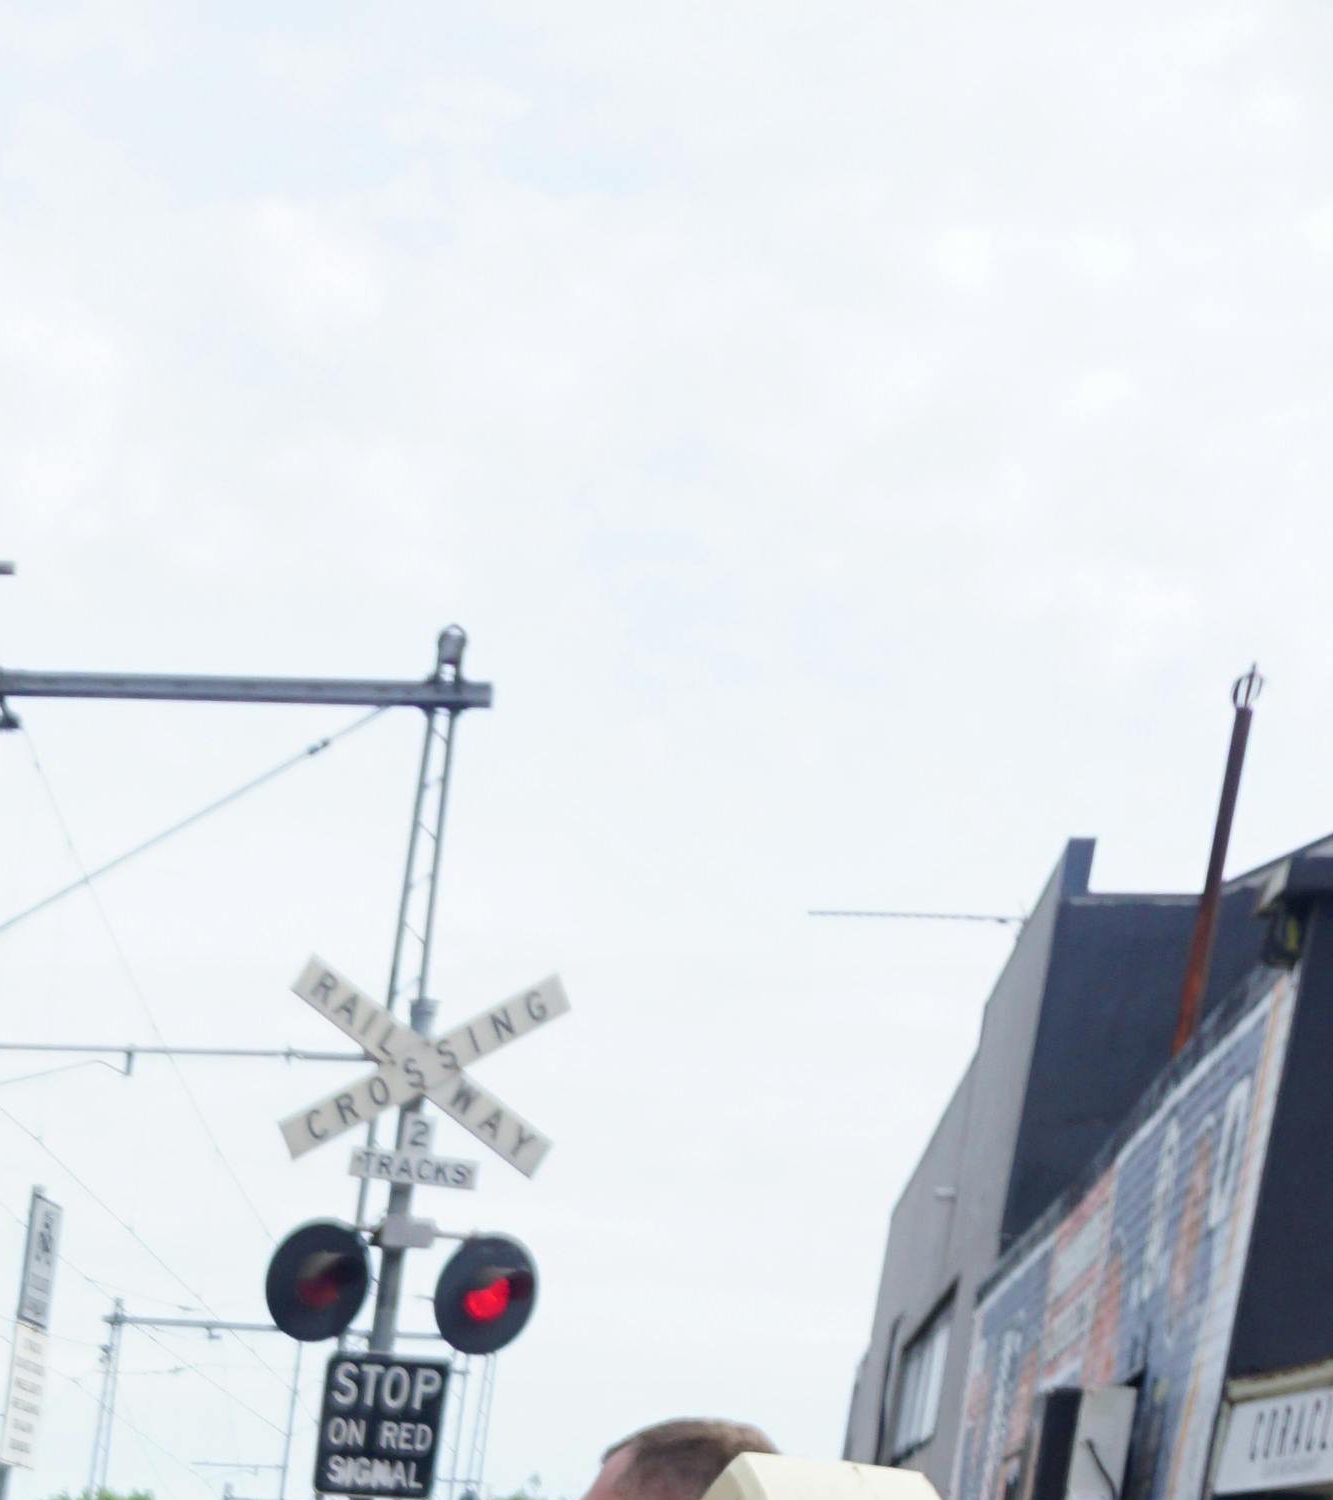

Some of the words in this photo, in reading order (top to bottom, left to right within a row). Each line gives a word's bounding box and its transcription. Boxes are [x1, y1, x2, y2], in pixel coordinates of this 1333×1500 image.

[305, 988, 549, 1141] CROSSING
[409, 1119, 430, 1148] 2
[362, 1151, 470, 1186] TRACKS
[331, 1360, 443, 1411] STOP
[327, 1416, 367, 1448] ON
[379, 1419, 434, 1451] RED
[325, 1454, 424, 1490] SIGNAL
